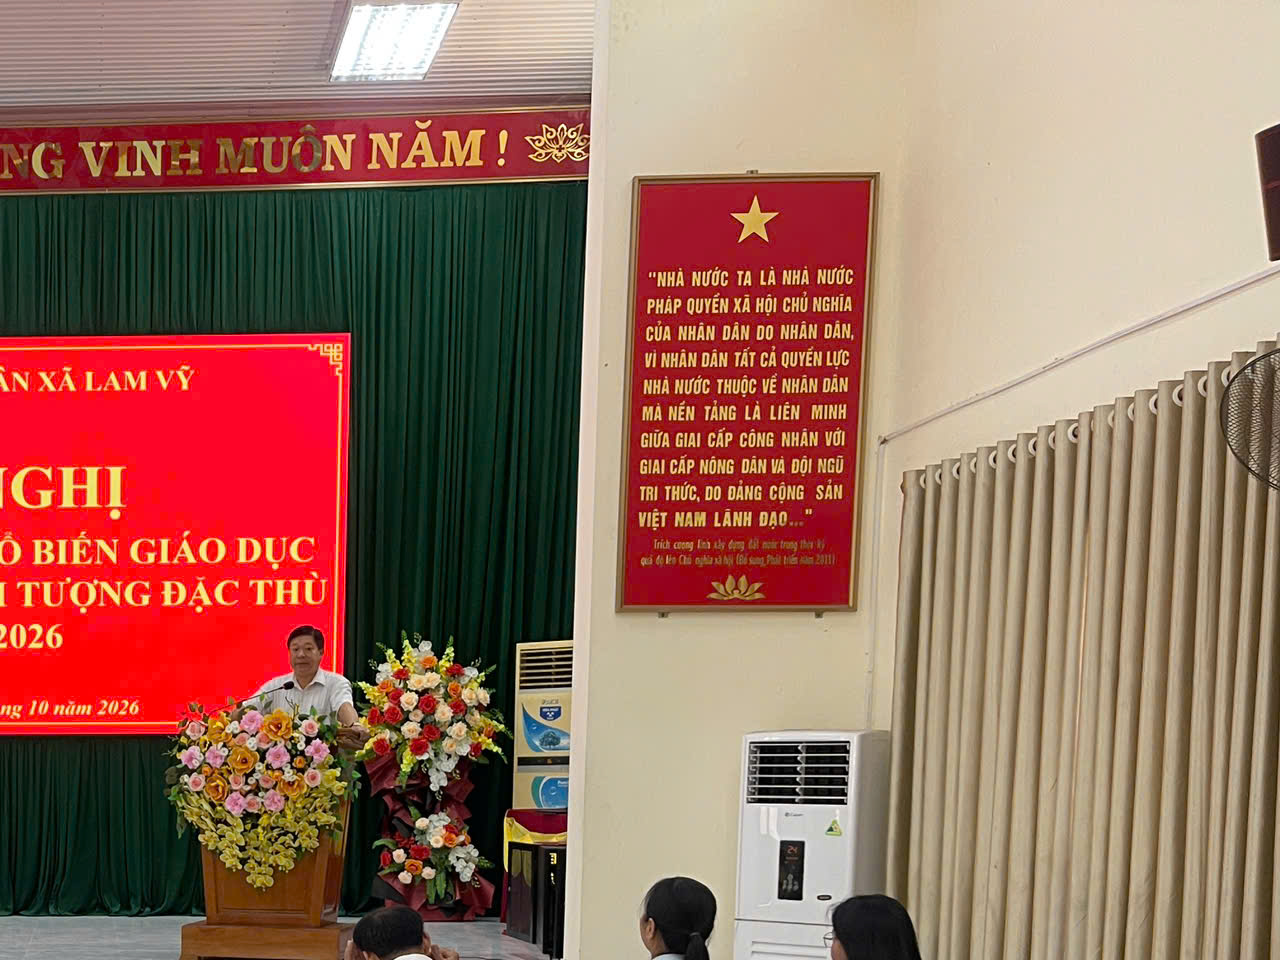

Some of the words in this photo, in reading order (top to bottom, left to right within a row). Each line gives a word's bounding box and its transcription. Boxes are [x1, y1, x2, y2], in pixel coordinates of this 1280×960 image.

[78, 140, 202, 177] VINH
[216, 124, 356, 173] MUÔN
[368, 120, 485, 169] NĂM
[692, 267, 728, 286] NƯỚC
[737, 271, 751, 286] TA
[760, 267, 776, 285] LÀ
[783, 266, 809, 285] NHÀ
[817, 265, 853, 284] NƯỚC
[647, 296, 681, 314] PHÁP
[733, 295, 750, 313] XÃ
[756, 294, 777, 316] HỘI
[783, 292, 808, 312] CHỦ
[813, 294, 852, 312] NGHĨA
[646, 321, 671, 341] CỦA
[678, 322, 715, 340] NHÂN
[723, 322, 750, 340] DÂN
[757, 325, 773, 340] DO
[781, 321, 817, 339] NHÂN
[824, 321, 853, 341] DÂN,
[645, 350, 656, 368] VÌ
[661, 349, 697, 368] NHÂN
[702, 349, 728, 367] DÂN
[735, 347, 756, 367] TẤT
[760, 346, 776, 367] CẢ
[826, 349, 849, 369] LỰC
[39, 367, 76, 391] XÃ
[86, 371, 146, 391] LAM
[156, 365, 194, 390] VỸ
[644, 376, 669, 394] NHÀ
[675, 375, 710, 394] NƯỚC
[717, 375, 756, 397] THUỘC
[782, 375, 818, 393] NHÂN
[823, 374, 848, 392] DÂN
[642, 403, 662, 421] MÀ
[704, 400, 736, 420] TẢNG
[745, 401, 760, 420] LÀ
[770, 402, 800, 420] LIÊN
[812, 404, 846, 419] MINH
[641, 430, 669, 448] GIỮA
[676, 433, 700, 447] GIAI
[708, 428, 733, 447] CẤP
[740, 429, 774, 447] CÔNG
[782, 429, 818, 447] NHÂN
[825, 427, 845, 446] VỚI
[640, 459, 665, 474] GIAI
[670, 455, 695, 474] CẤP
[700, 456, 734, 474] NÔNG
[742, 456, 767, 473] DÂN
[772, 456, 785, 474] VÀ
[792, 456, 812, 476] ĐỘI
[818, 456, 843, 473] NGŨ
[640, 486, 658, 501] TRI
[665, 482, 700, 502] THỨC,
[705, 486, 721, 500] DO
[728, 480, 762, 500] ĐẢNG
[770, 482, 804, 503] CỘNG
[816, 479, 842, 500] SẢN
[639, 509, 667, 530] VIỆT
[675, 512, 706, 527] NAM
[714, 509, 752, 527] LÃNH
[32, 531, 118, 564] BIẾN
[130, 531, 226, 564] GIÁO
[238, 537, 314, 570] DỤC
[17, 577, 151, 613] TƯỢNG
[161, 577, 239, 613] ĐẶC
[249, 572, 327, 605] THÙ
[29, 700, 49, 715] 10
[53, 701, 92, 715] năm
[97, 700, 139, 715] 2026
